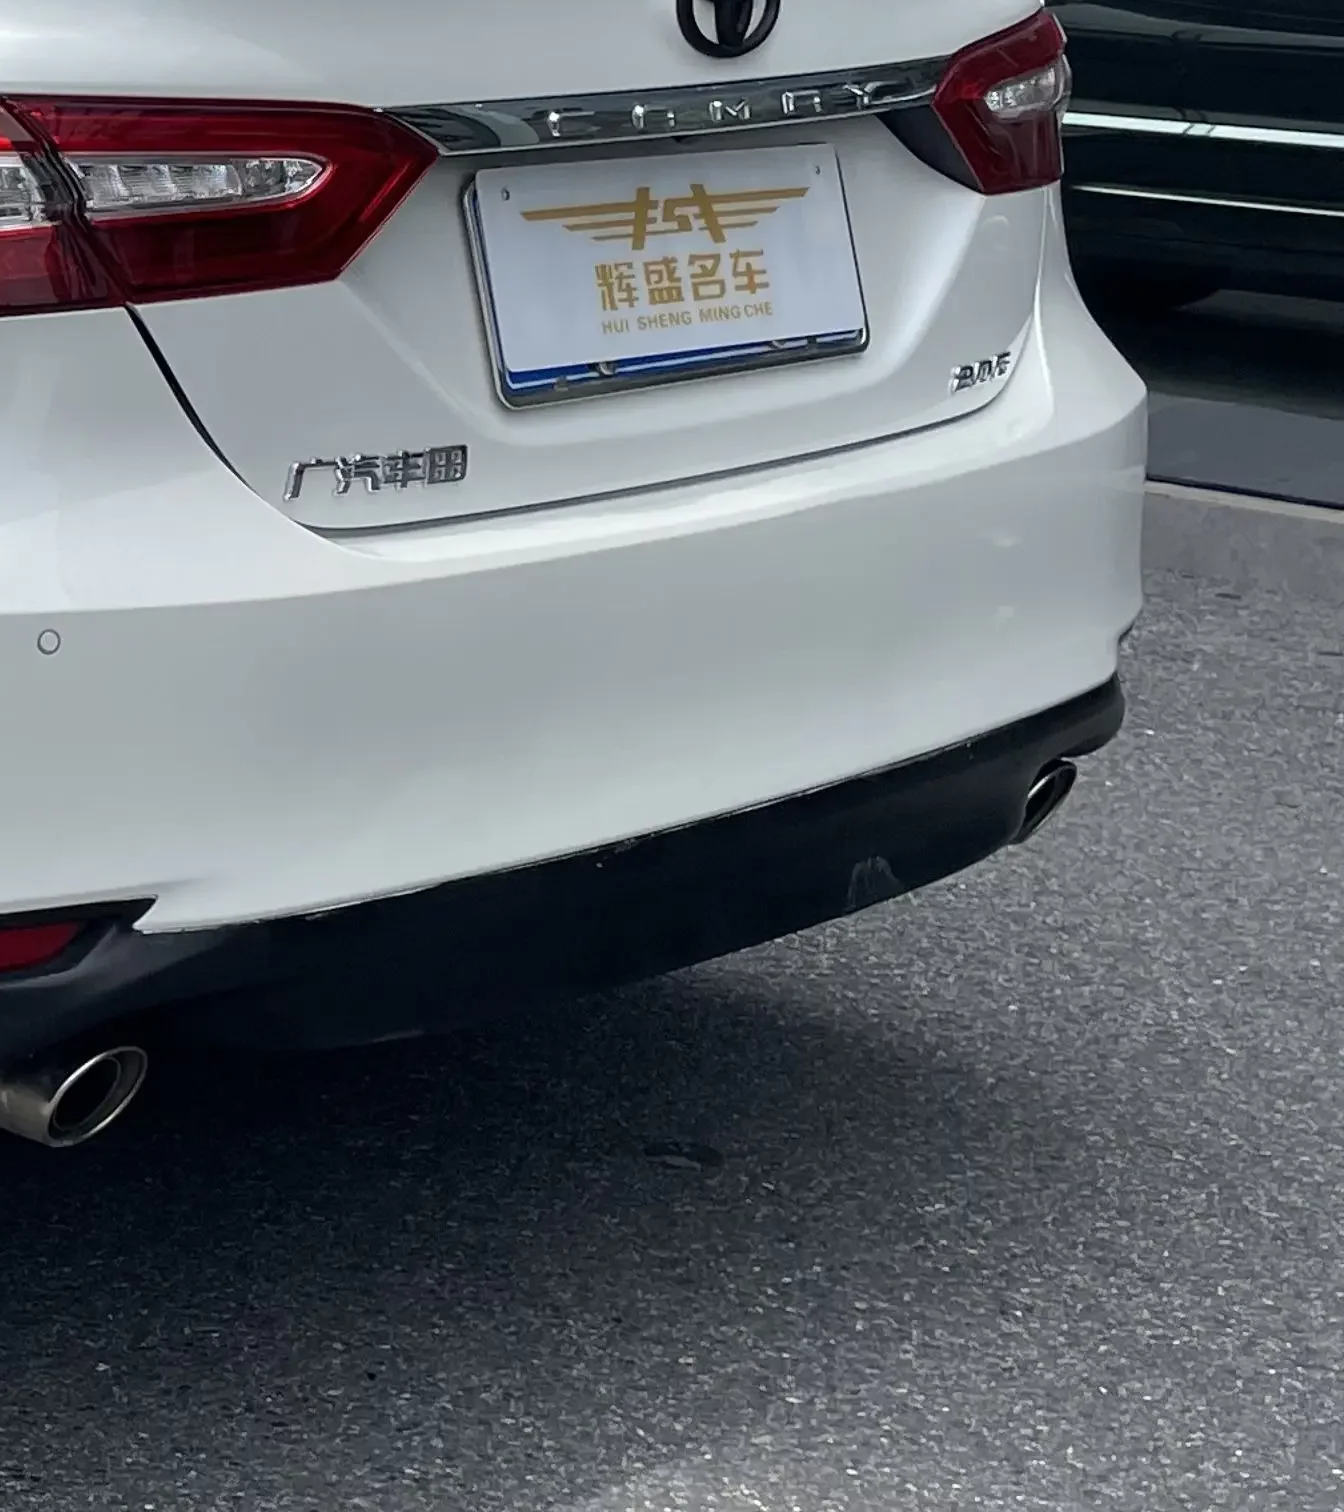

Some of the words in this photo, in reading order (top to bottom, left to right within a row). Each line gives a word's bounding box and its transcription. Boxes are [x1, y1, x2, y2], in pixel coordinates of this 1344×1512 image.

[545, 80, 900, 138] CAMRY
[594, 249, 770, 311] 辉盛名车
[601, 319, 630, 335] HUI
[637, 310, 693, 331] SHENG
[282, 444, 468, 501] 广汽丰田
